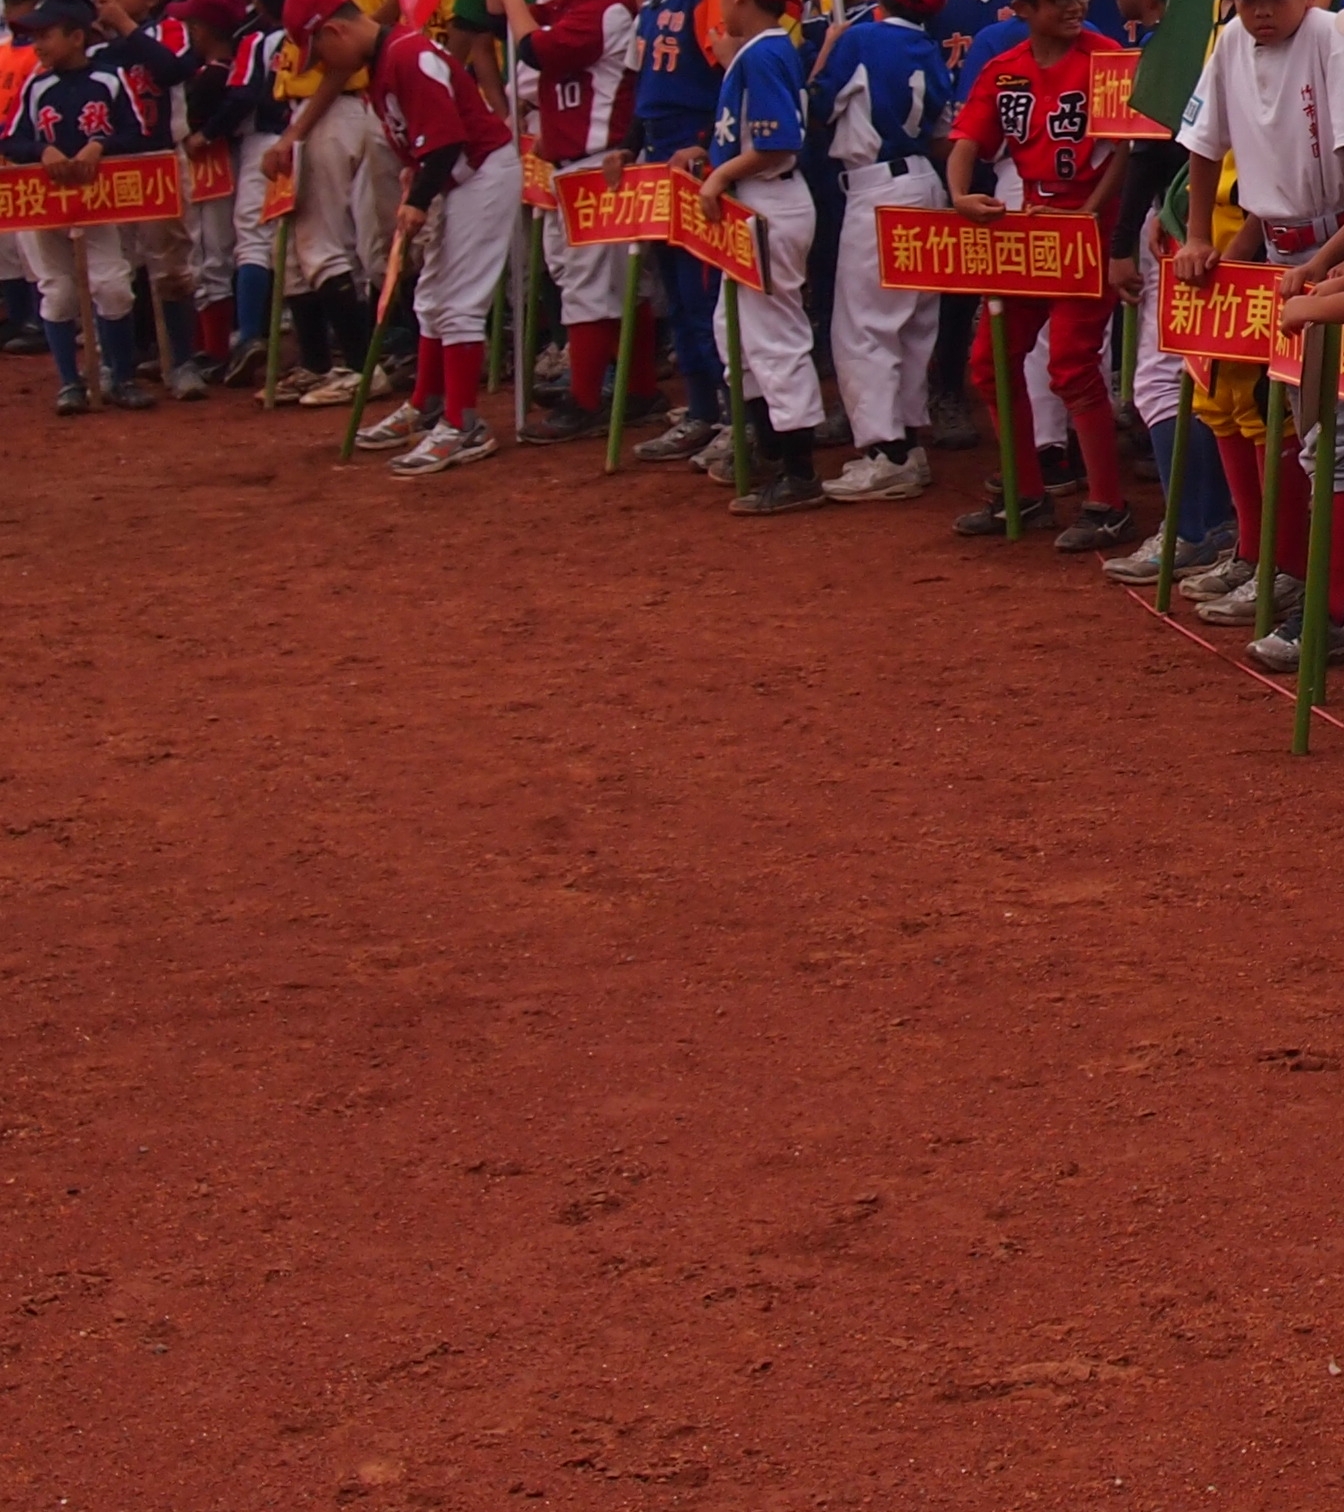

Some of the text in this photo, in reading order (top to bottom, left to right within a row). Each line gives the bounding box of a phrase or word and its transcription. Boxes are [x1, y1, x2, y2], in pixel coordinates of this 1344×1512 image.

[555, 81, 581, 111] 10
[902, 69, 927, 139] 1
[36, 100, 113, 142] 千秋
[1055, 147, 1076, 181] 6
[891, 224, 1097, 280] 新竹關西國小
[1168, 281, 1272, 340] 新竹東
